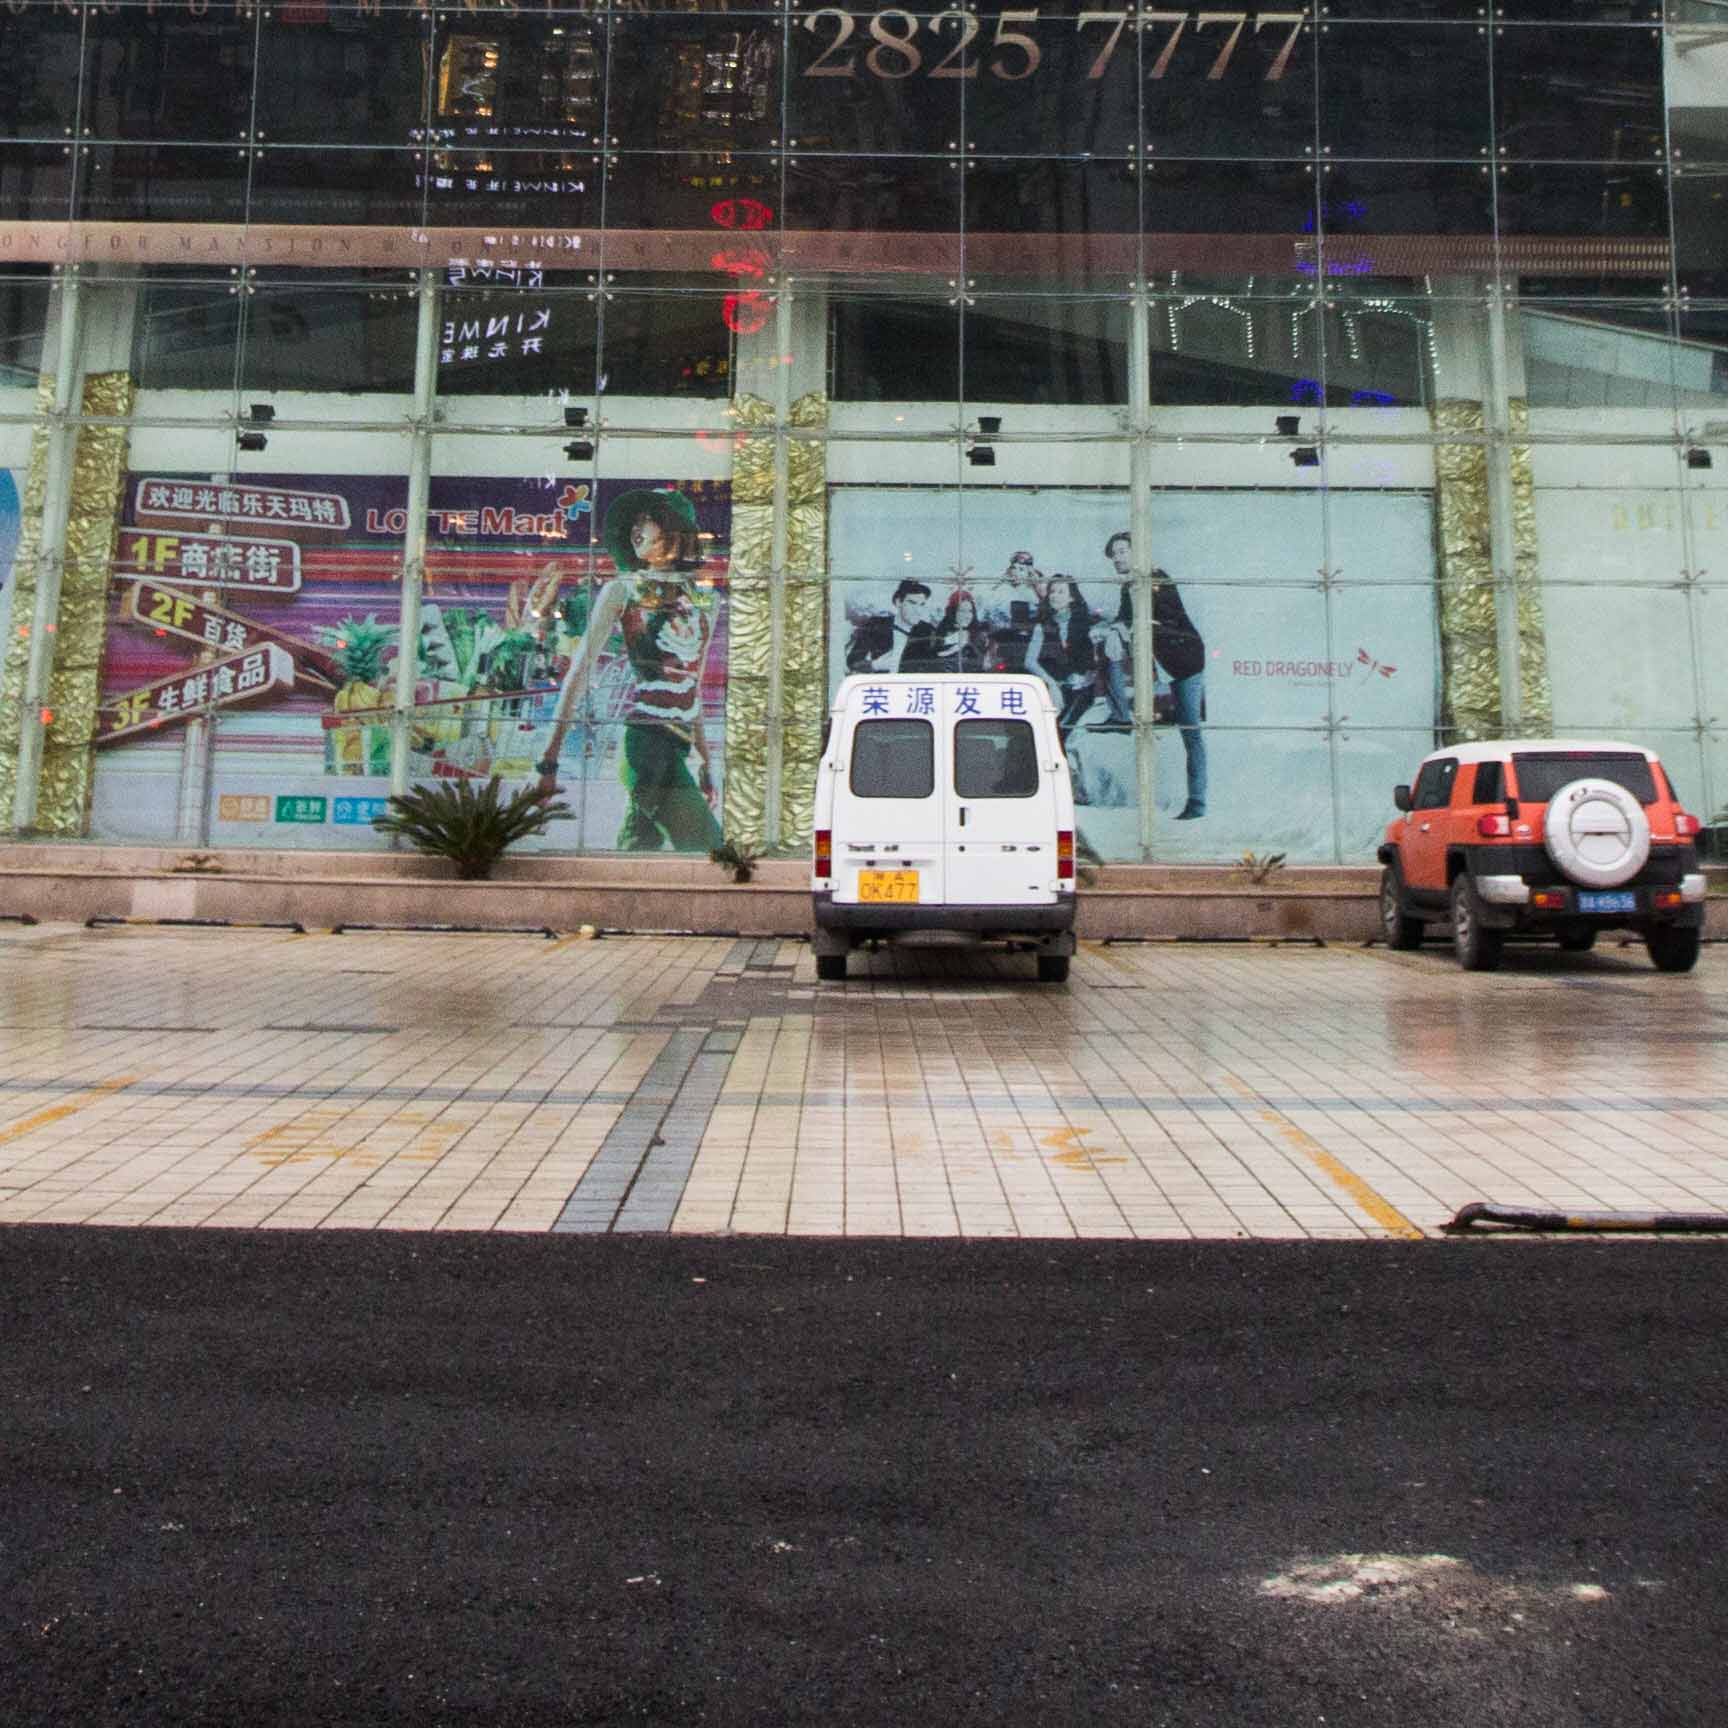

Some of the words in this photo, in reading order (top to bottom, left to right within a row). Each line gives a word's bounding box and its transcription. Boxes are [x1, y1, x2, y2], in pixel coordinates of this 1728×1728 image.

[803, 7, 1041, 80] 2825
[1076, 10, 1306, 80] 7777
[149, 486, 336, 523] 欢迎光临乐天玛特
[481, 506, 568, 535] Mart
[131, 535, 180, 572] 1F
[149, 591, 195, 627] 2F
[202, 612, 248, 651] 百货
[158, 653, 266, 715] 生鲜食品
[862, 687, 1028, 716] 荣源发电
